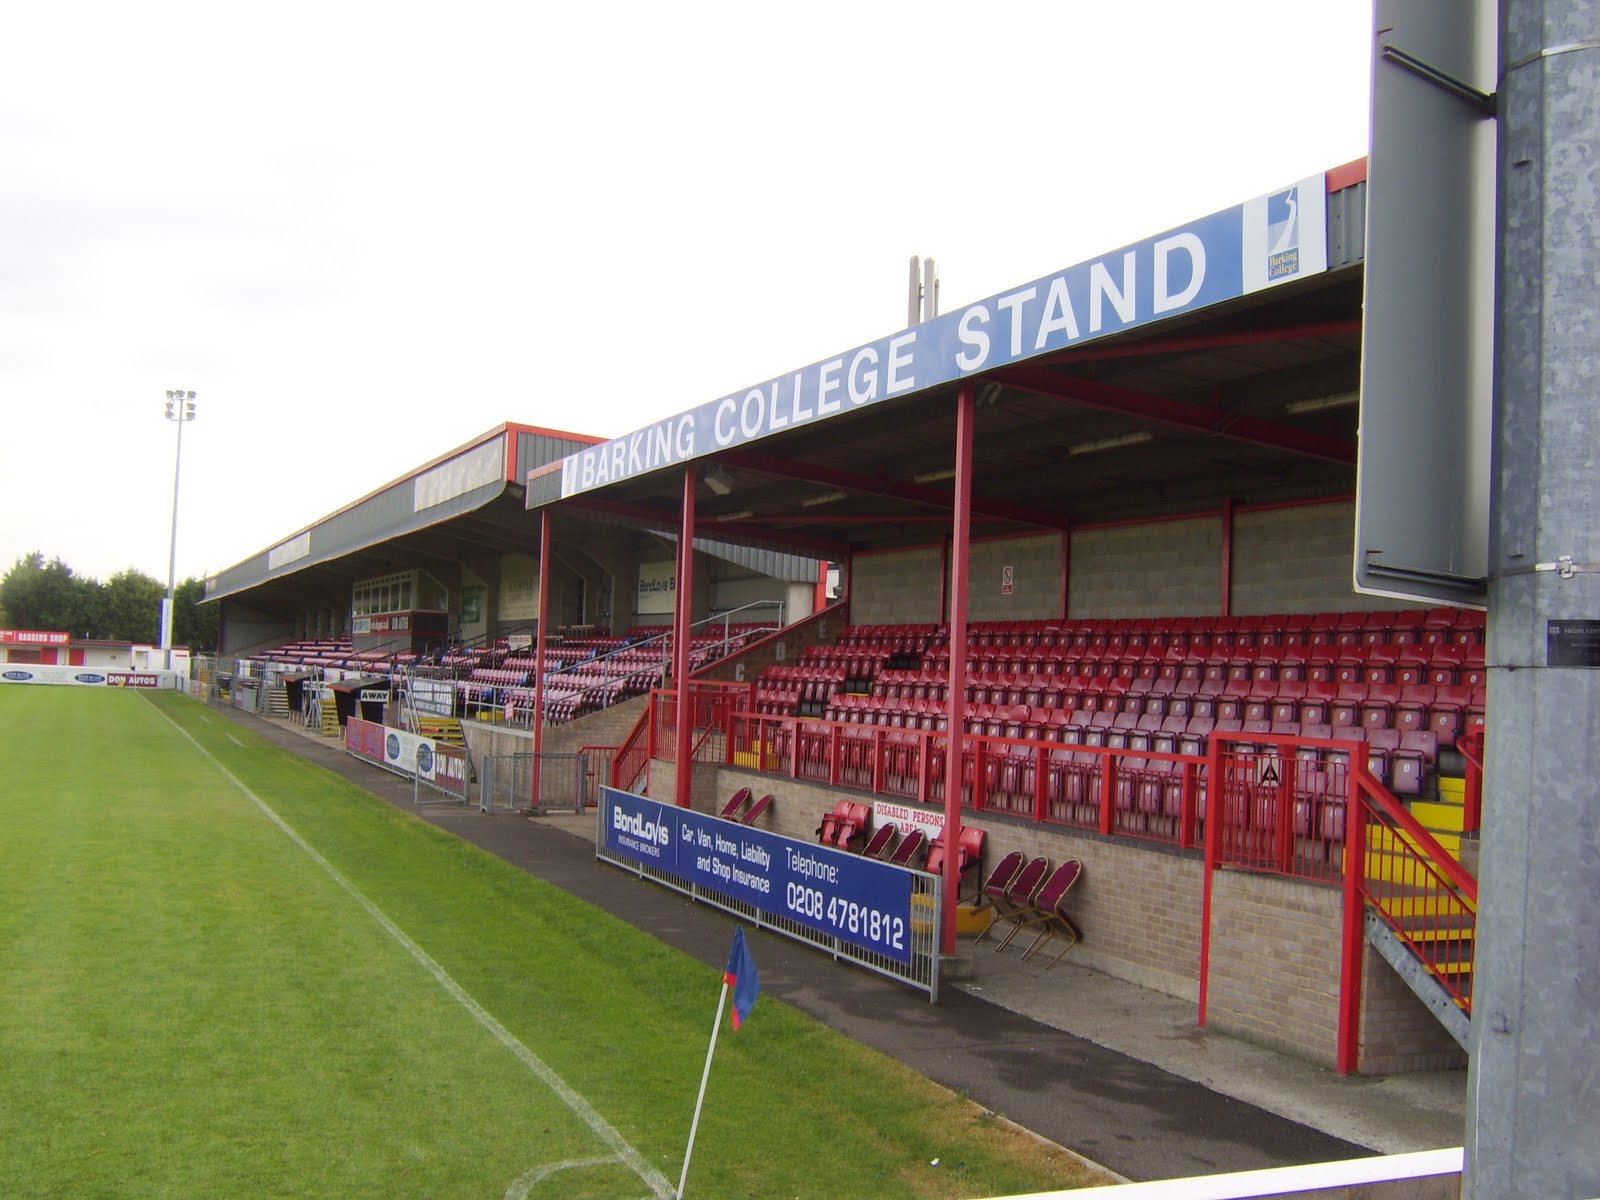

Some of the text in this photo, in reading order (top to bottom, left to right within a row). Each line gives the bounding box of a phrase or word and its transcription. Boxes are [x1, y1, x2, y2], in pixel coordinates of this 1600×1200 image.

[1269, 252, 1297, 267] Barking
[1269, 263, 1297, 277] College
[582, 232, 1206, 489] BARKING COLLEGE STAND
[49, 634, 68, 643] SHOP
[108, 675, 126, 684] DON
[128, 675, 156, 685] AUTOS
[735, 663, 745, 682] C
[361, 691, 388, 700] AWAY
[876, 803, 944, 828] DISABLED PERSONS
[618, 834, 660, 858] INSURANCE BROKERS
[681, 823, 771, 873] Car, Van, Home, Liability
[696, 855, 770, 894] and Shop Insurance
[785, 846, 839, 885] Telephone:
[786, 881, 904, 951] 0208 4781812
